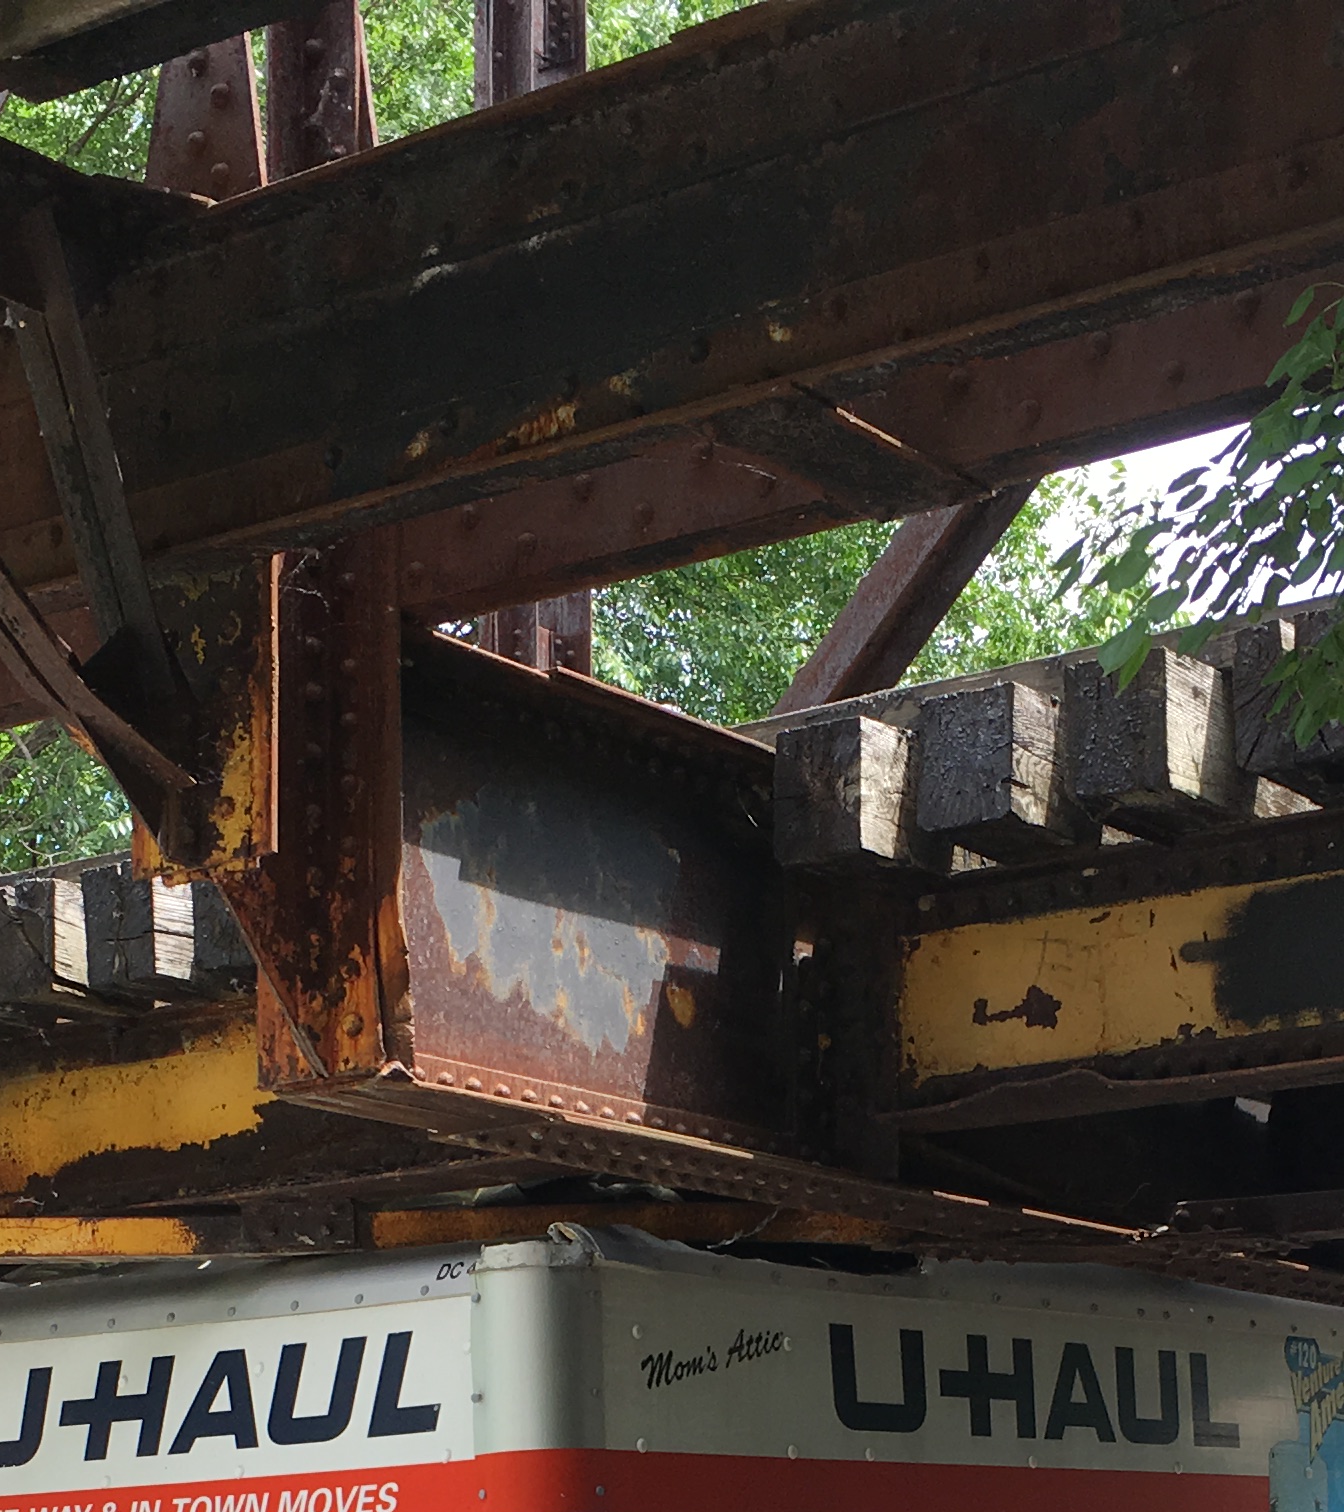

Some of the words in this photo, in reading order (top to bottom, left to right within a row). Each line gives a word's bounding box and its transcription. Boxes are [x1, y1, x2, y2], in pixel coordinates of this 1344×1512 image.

[436, 1261, 464, 1281] DC
[640, 1345, 718, 1390] Mom's
[725, 1328, 783, 1369] Attic
[828, 1323, 1240, 1448] U-HAUL
